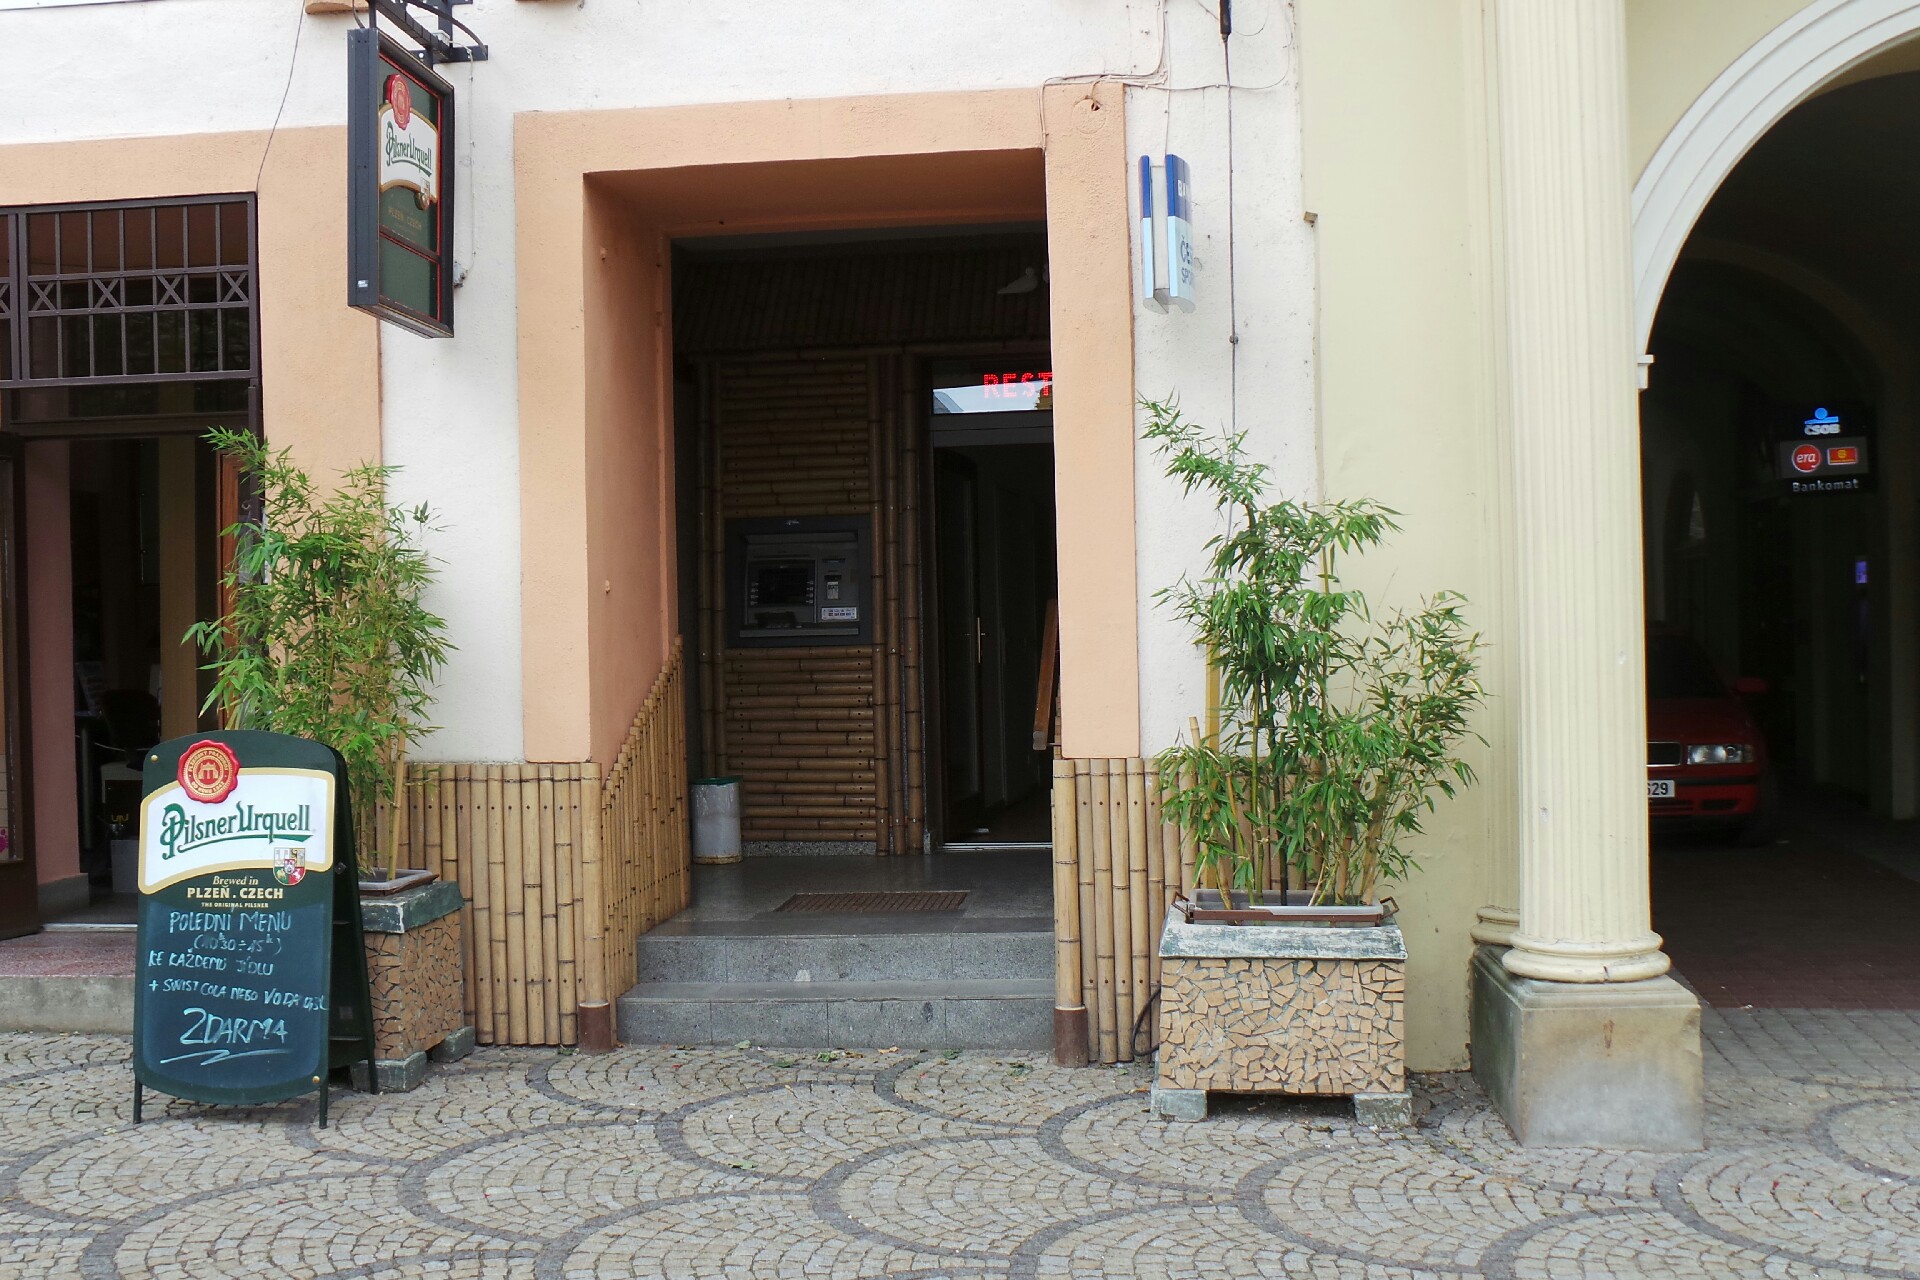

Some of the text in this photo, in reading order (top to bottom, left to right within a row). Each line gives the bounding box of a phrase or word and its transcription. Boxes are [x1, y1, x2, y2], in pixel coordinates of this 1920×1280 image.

[386, 121, 432, 173] Pilsner Urquell
[1796, 453, 1816, 463] era
[1792, 479, 1859, 492] Bankomat
[160, 801, 310, 860] Pilsner Urquell
[212, 875, 259, 886] Brewed in
[187, 883, 284, 899] PLZEŇ CZECH
[239, 911, 292, 933] MENU
[148, 950, 165, 967] KE
[179, 1007, 289, 1045] ZDARMA
